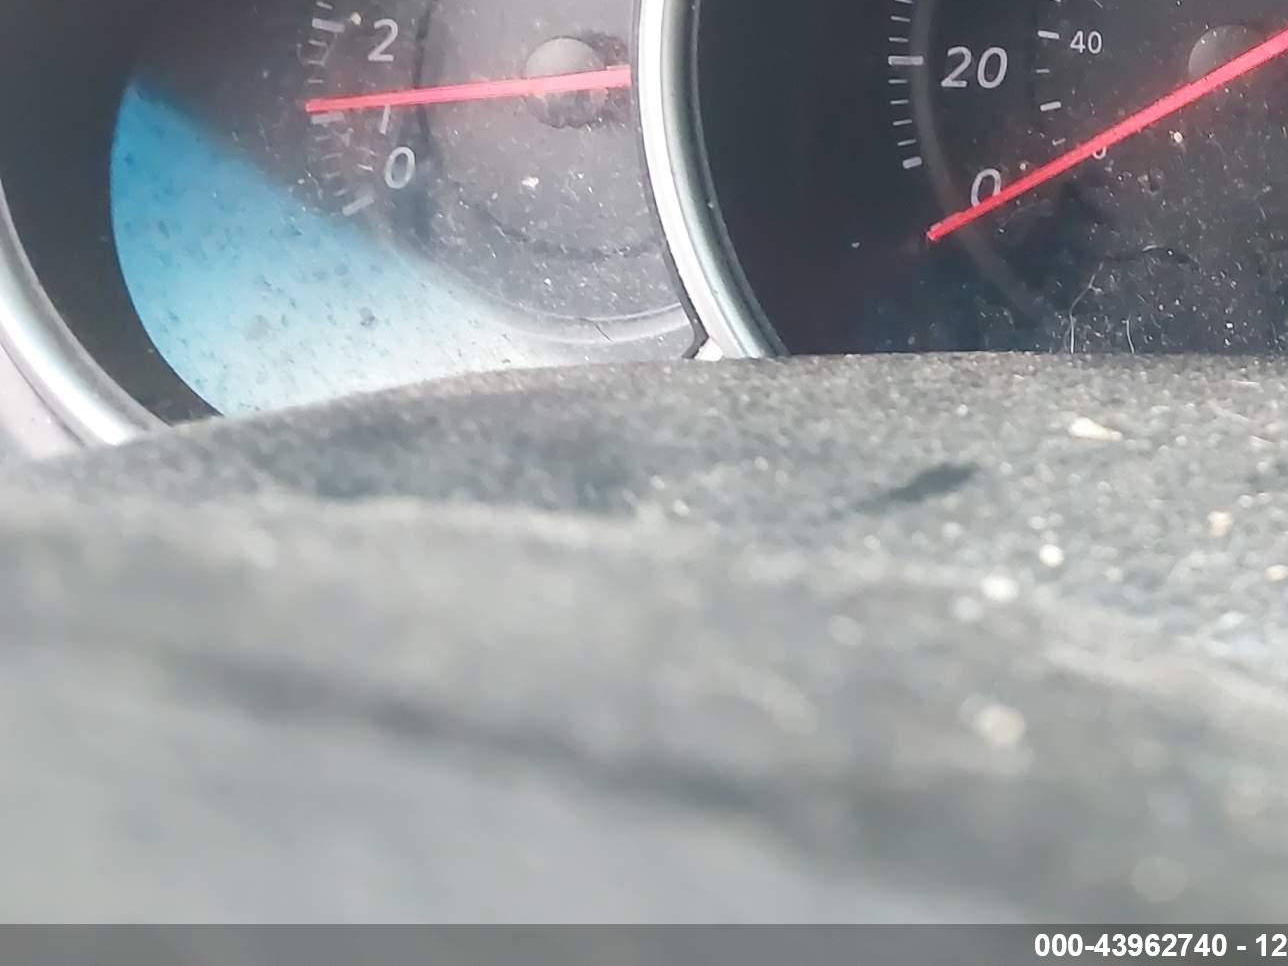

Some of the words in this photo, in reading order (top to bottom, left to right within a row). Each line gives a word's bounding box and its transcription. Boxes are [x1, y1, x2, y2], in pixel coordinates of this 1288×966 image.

[368, 19, 398, 61] 2
[1070, 31, 1102, 54] 40
[941, 47, 1008, 88] 20
[384, 146, 415, 189] 0
[971, 168, 1001, 207] 0
